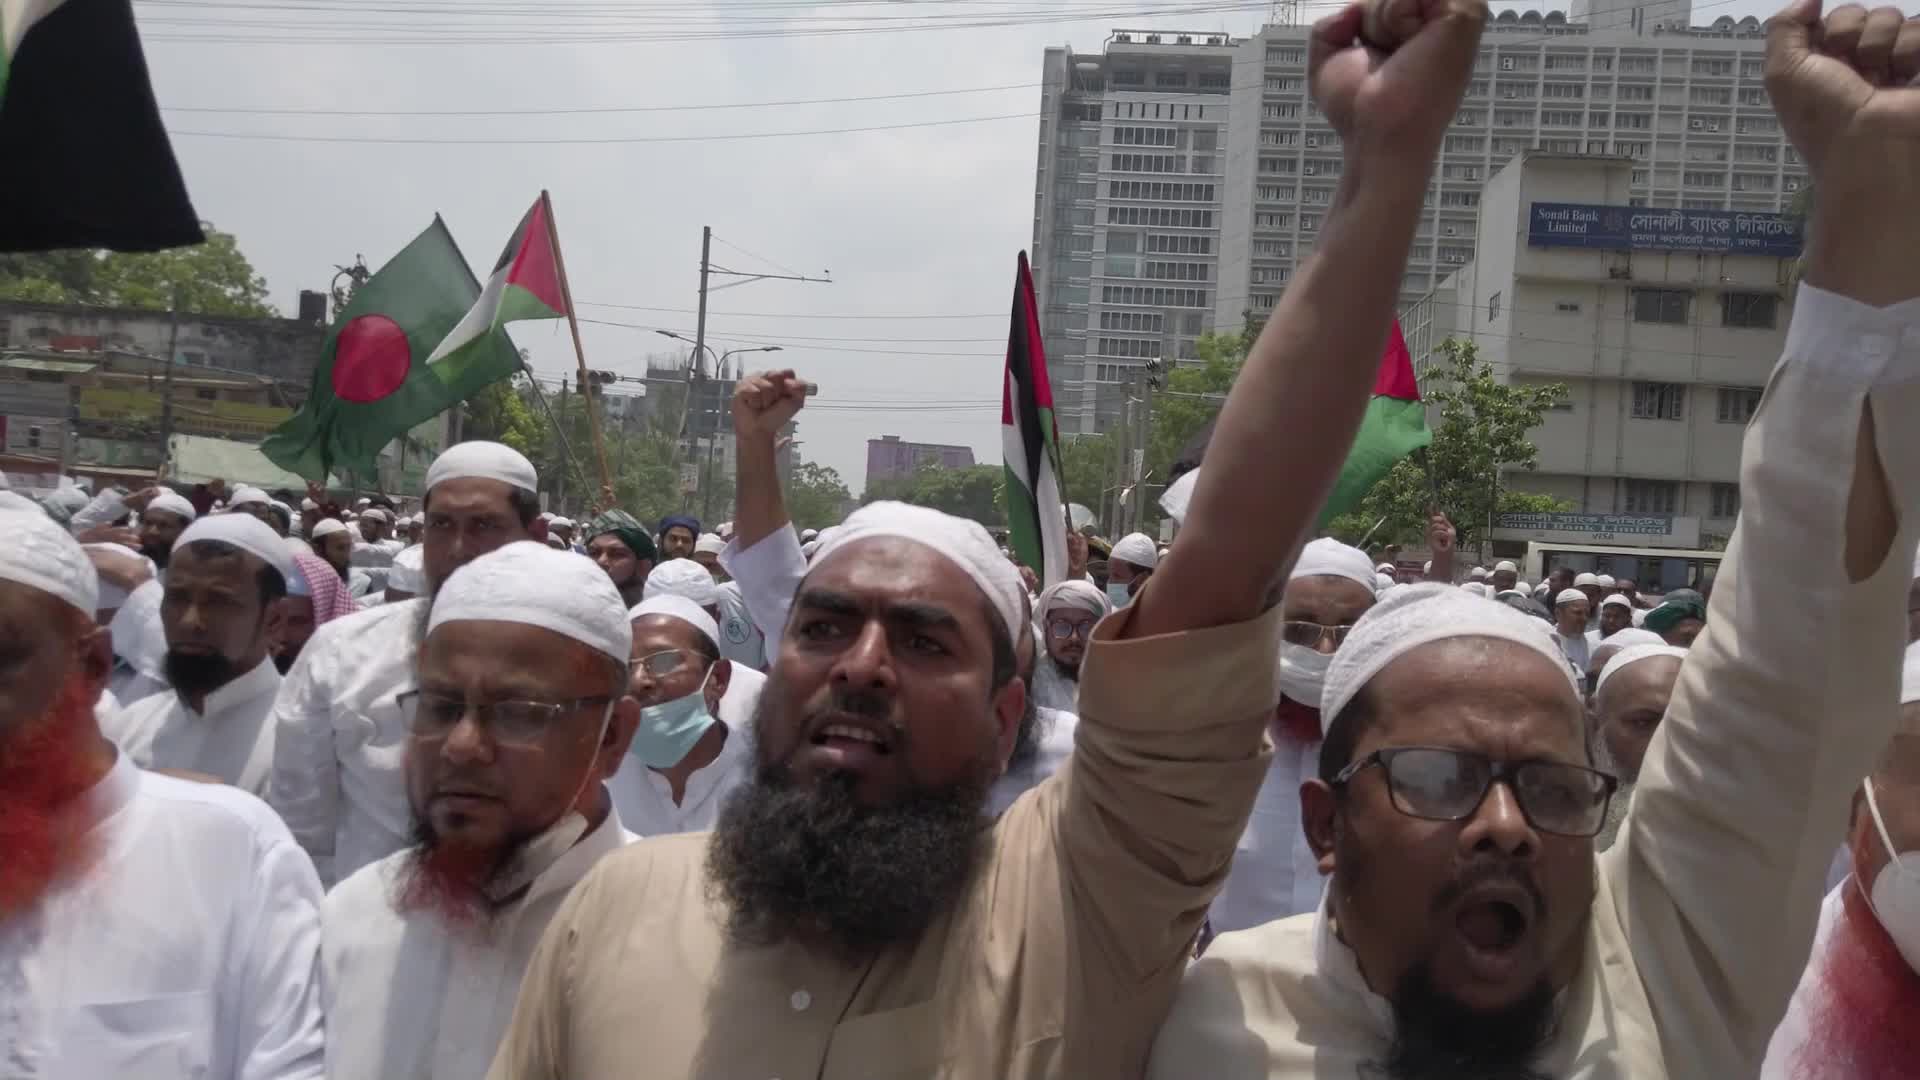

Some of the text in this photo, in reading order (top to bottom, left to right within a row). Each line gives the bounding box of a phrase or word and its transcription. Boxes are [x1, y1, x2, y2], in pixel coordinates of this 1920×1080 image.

[1537, 207, 1599, 222] Sonali Bank
[1548, 221, 1588, 233] Limited
[1630, 210, 1793, 235] সোনালী ব্যাংক লিমিটেড
[1553, 522, 1600, 532] Bank
[1602, 524, 1667, 535] Limited
[1592, 532, 1615, 541] VISA
